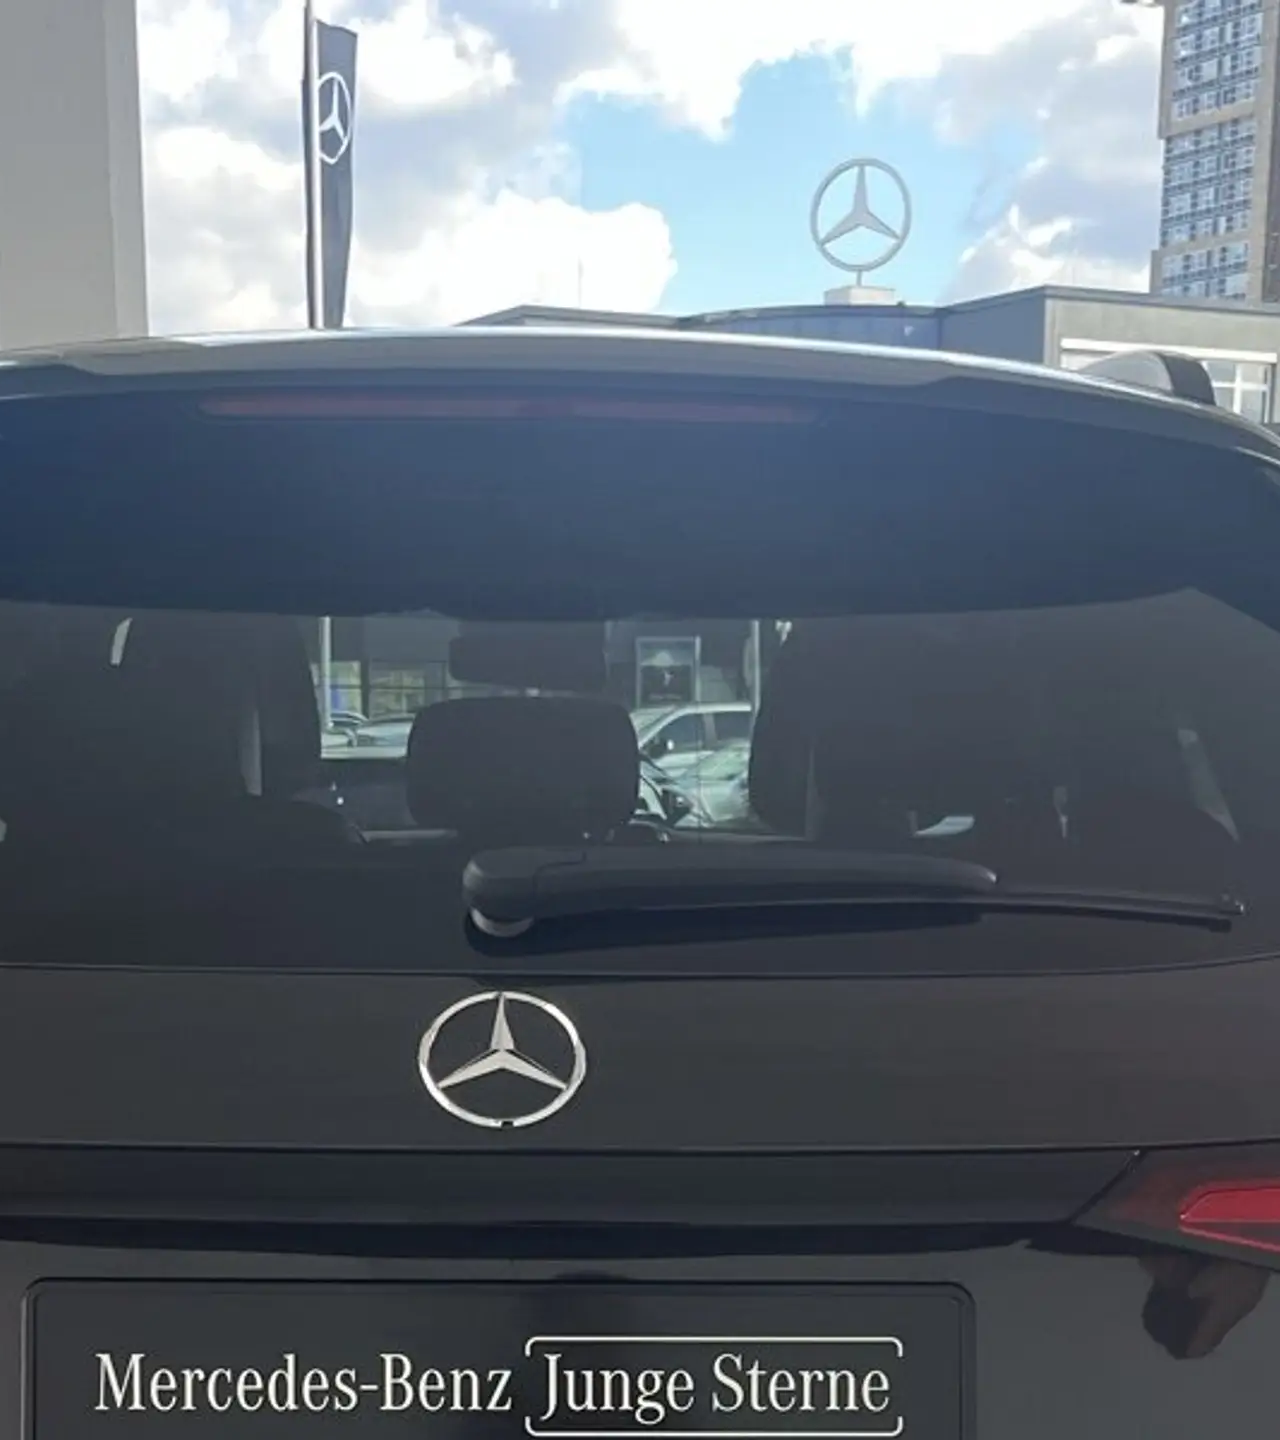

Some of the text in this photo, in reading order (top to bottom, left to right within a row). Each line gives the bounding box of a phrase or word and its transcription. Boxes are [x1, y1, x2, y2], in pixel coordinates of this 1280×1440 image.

[94, 1352, 891, 1426] Mercedes-Benz Junge Sterne
